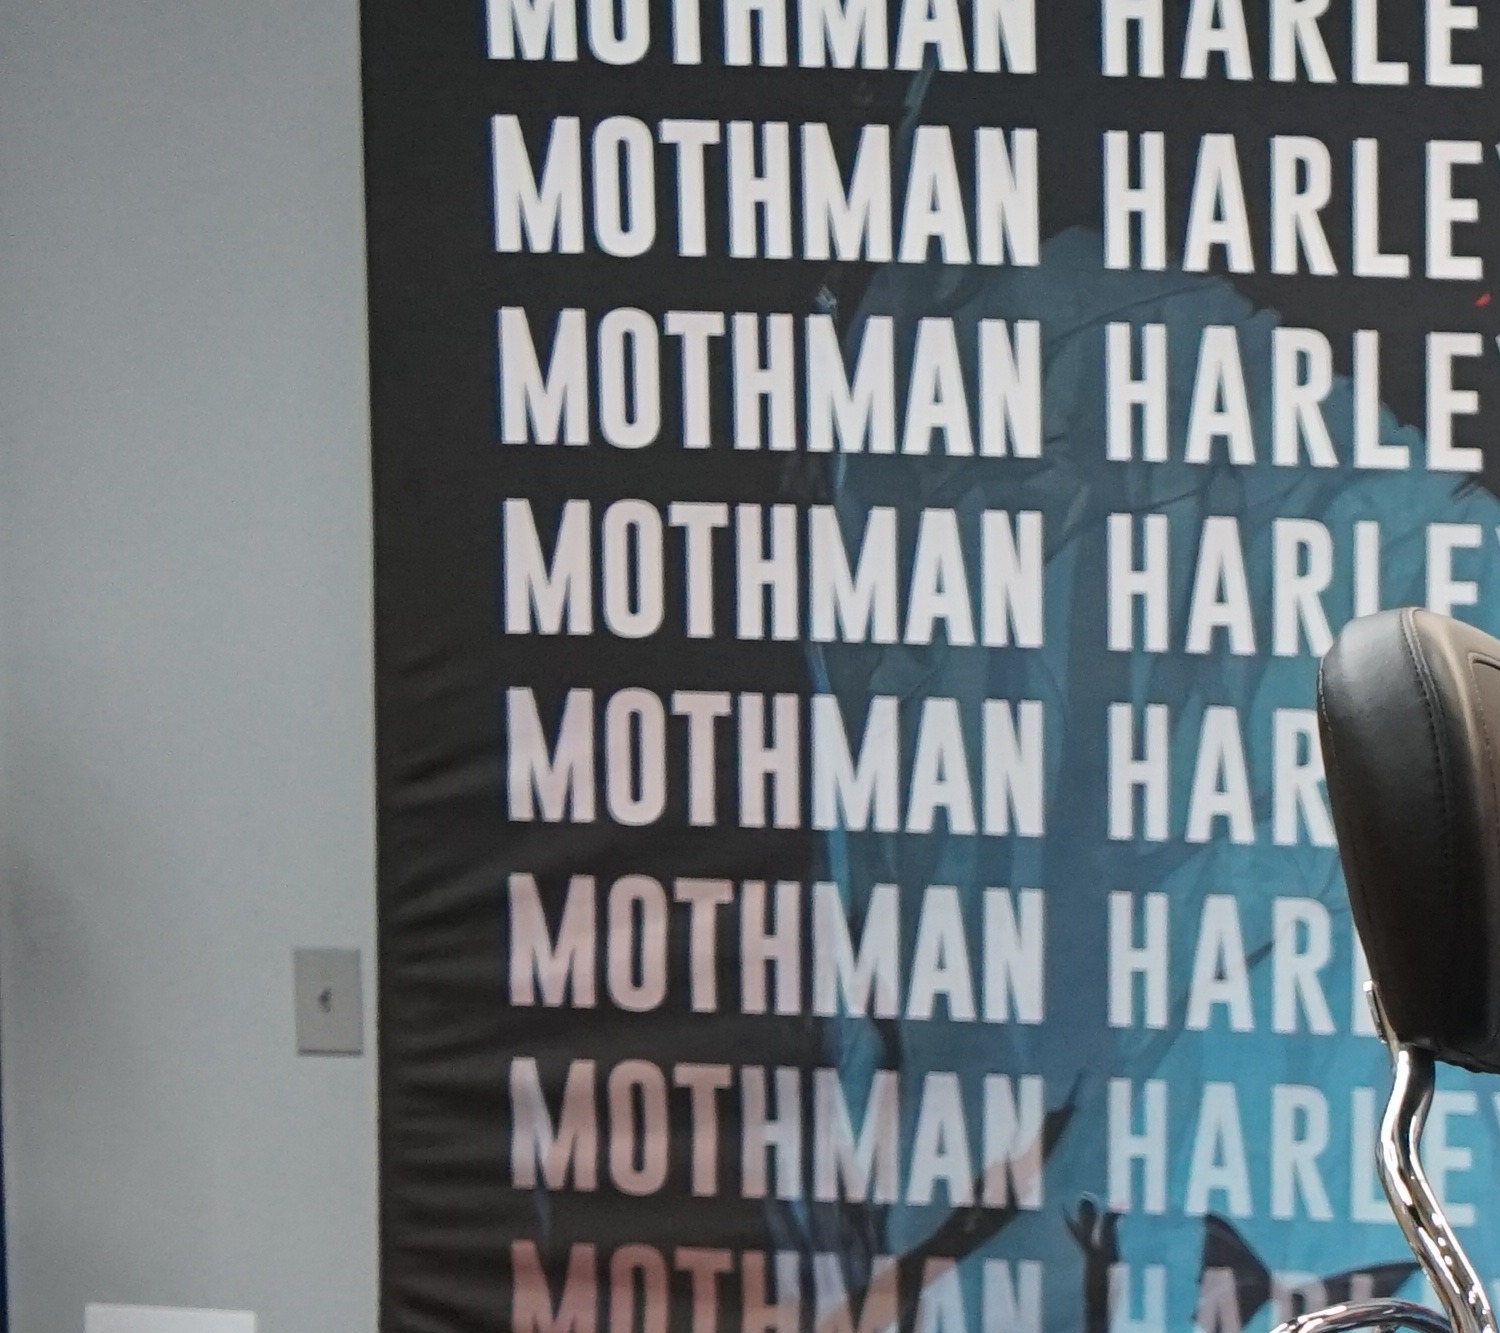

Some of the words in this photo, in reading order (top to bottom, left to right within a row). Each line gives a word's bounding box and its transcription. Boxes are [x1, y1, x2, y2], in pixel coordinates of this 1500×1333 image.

[491, 114, 1041, 267] MOTHMAN
[498, 307, 1042, 459] MOTHMAN
[503, 498, 1044, 649] MOTHMAN
[506, 686, 1044, 837] MOTHMAN
[508, 872, 1044, 1024] MOTHMAN
[510, 1056, 1044, 1210] MOTHMAN
